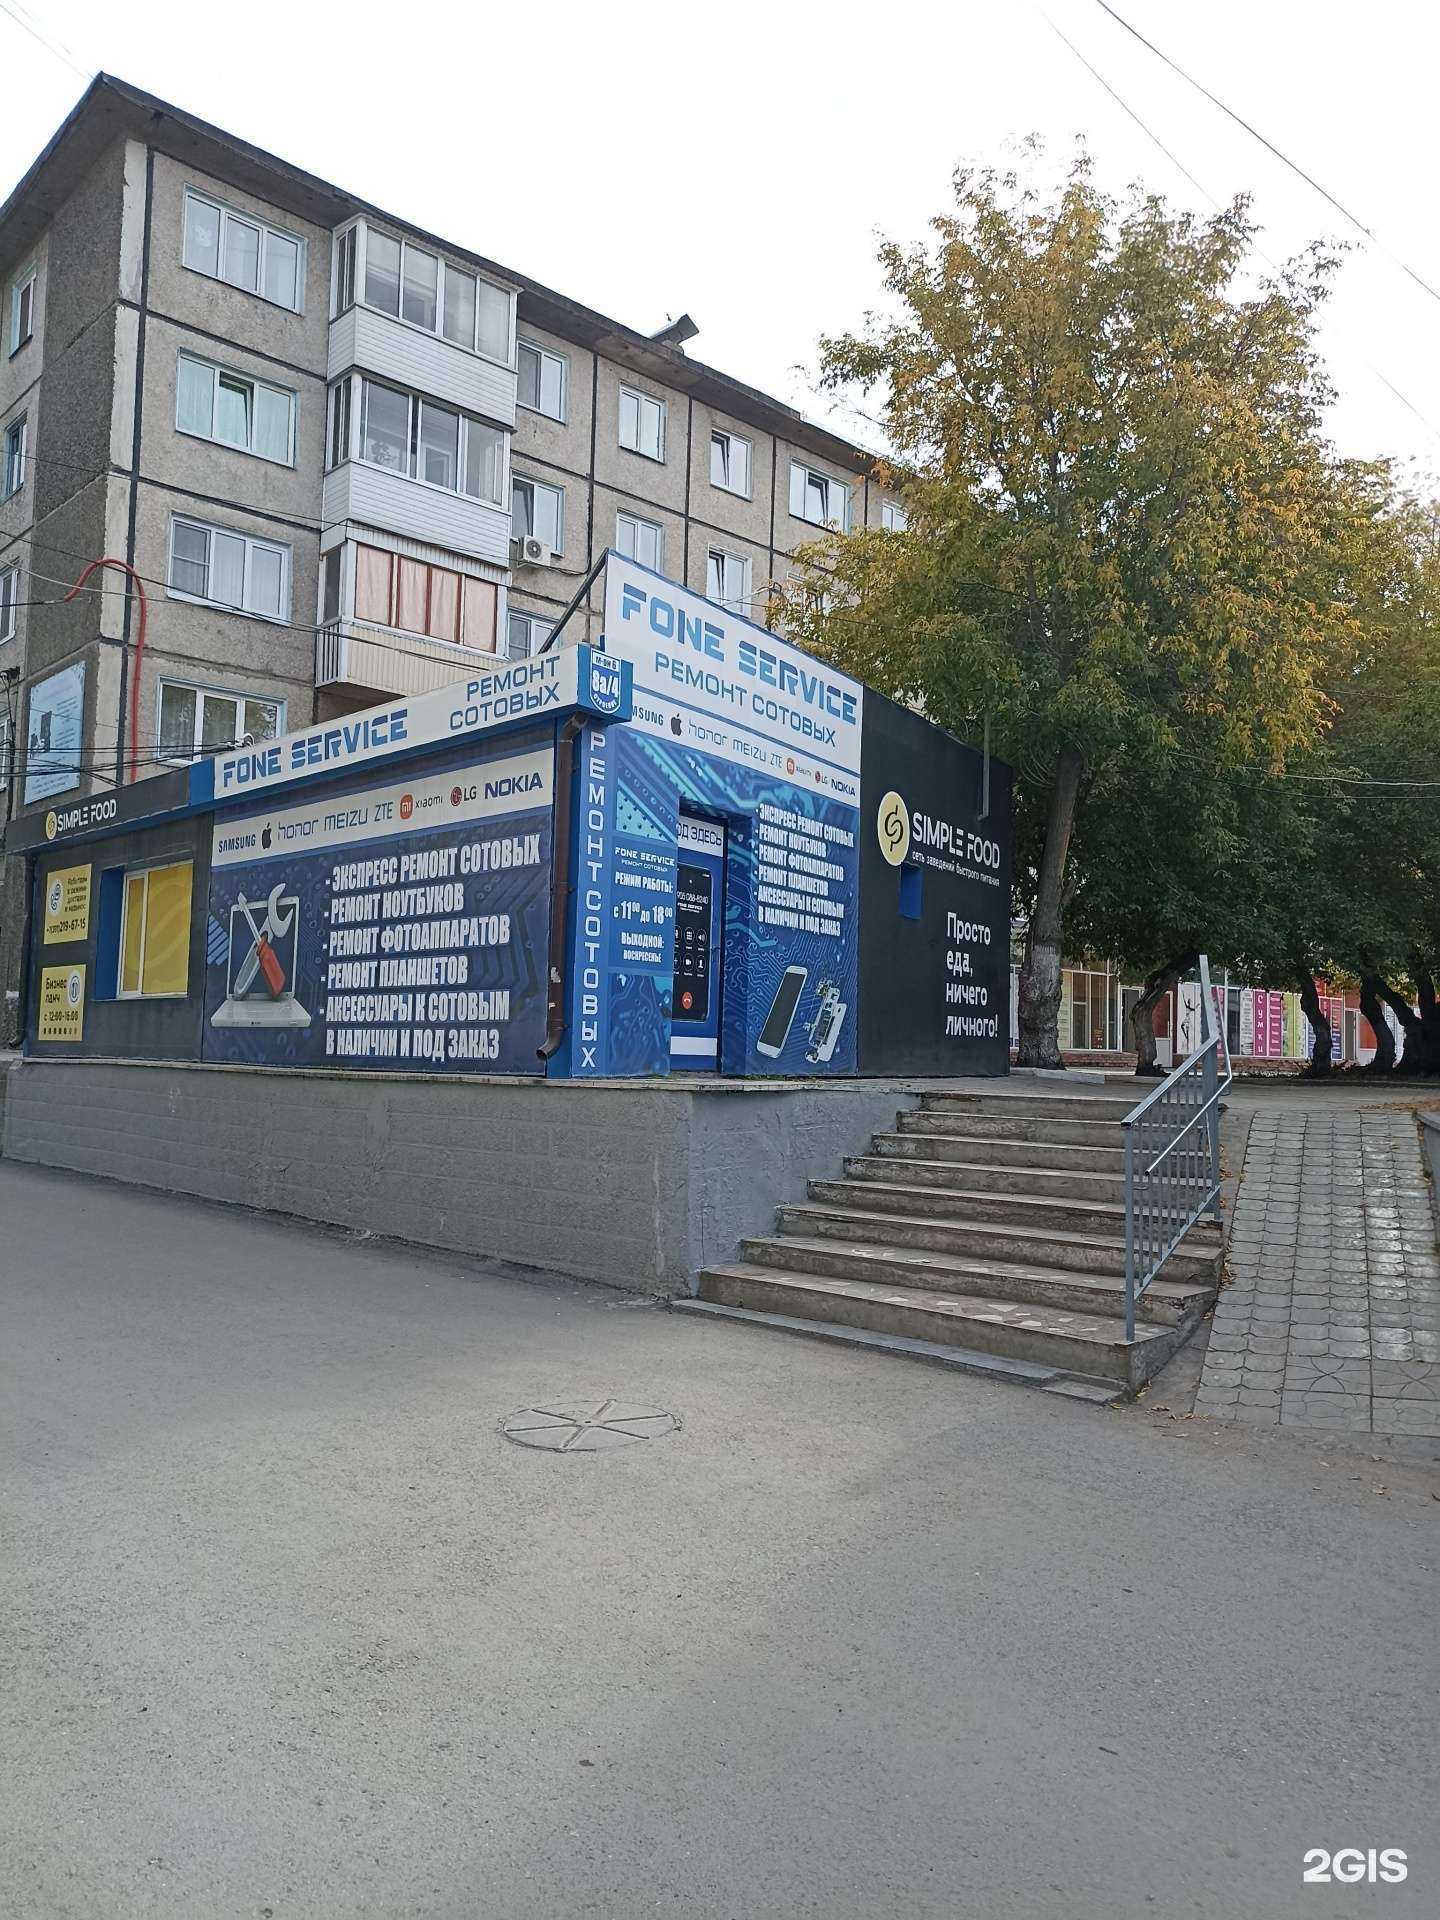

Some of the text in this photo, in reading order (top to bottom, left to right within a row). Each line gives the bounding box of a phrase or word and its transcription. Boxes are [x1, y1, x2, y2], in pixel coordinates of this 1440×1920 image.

[623, 583, 857, 725] FONE SERVICE
[467, 656, 560, 701] РЕМОНТ
[450, 682, 560, 730] СОТОВЫХ
[656, 652, 836, 747] РЕМОНТ СОТОВЫХ
[224, 709, 408, 788] FONE SERVICE
[771, 754, 782, 768] ZTE
[832, 779, 855, 796] NOKIA
[58, 799, 116, 831] SIMPLE FOOD
[219, 834, 256, 853] SAMSUNG
[278, 820, 318, 840] honor
[374, 801, 393, 822] ZTE
[464, 786, 476, 801] LG
[485, 772, 543, 800] NOKIA
[760, 803, 854, 848] ЭКСПРЕСС РЕМОНТ СОТОВЫХ
[691, 827, 722, 845] ЗДЕСЬ
[759, 824, 826, 857] РЕМОНТ НОУТБУКОВ
[913, 812, 1000, 868] SIMPLE FOOD
[332, 834, 540, 891] ЭКСПРЕСС РЕМОНТ СОТОВЫХ
[615, 847, 675, 866] FONE SERVICE
[759, 845, 788, 866] РЕМОНТ
[912, 851, 924, 863] сеть
[615, 872, 673, 894] РЕЖИМ РАБОТЫ:
[759, 865, 828, 896] РЕМОНТ ПЛАНШЕТОВ
[331, 883, 464, 923] РЕМОНТ НОУТБУКОВ
[581, 731, 606, 1067] РЕМОНТ СОТОВЫХ
[758, 885, 844, 918] АКСЕССУАРЫ К СОТОВЫМ
[640, 910, 649, 923] до
[758, 906, 840, 936] В НАЛИЧИИ И ПОД ЗАКАЗ
[947, 912, 991, 946] Просто
[330, 914, 510, 956] РЕМОНТ ФОТОАППАРАТОВ
[328, 955, 468, 988] РЕМОНТ ПЛАНШЕТОВ
[624, 950, 662, 963] ВОСКРЕСЕНЬЕ
[946, 950, 973, 977] еда,
[46, 978, 67, 989] Бизнес
[946, 982, 988, 1006] ничего
[326, 991, 509, 1021] АКСЕССУАРЫ К СОТОВЫМ
[945, 1015, 998, 1038] личного!
[326, 1029, 499, 1062] В НАЛИЧИИ И ПОД ЗАКАЗ
